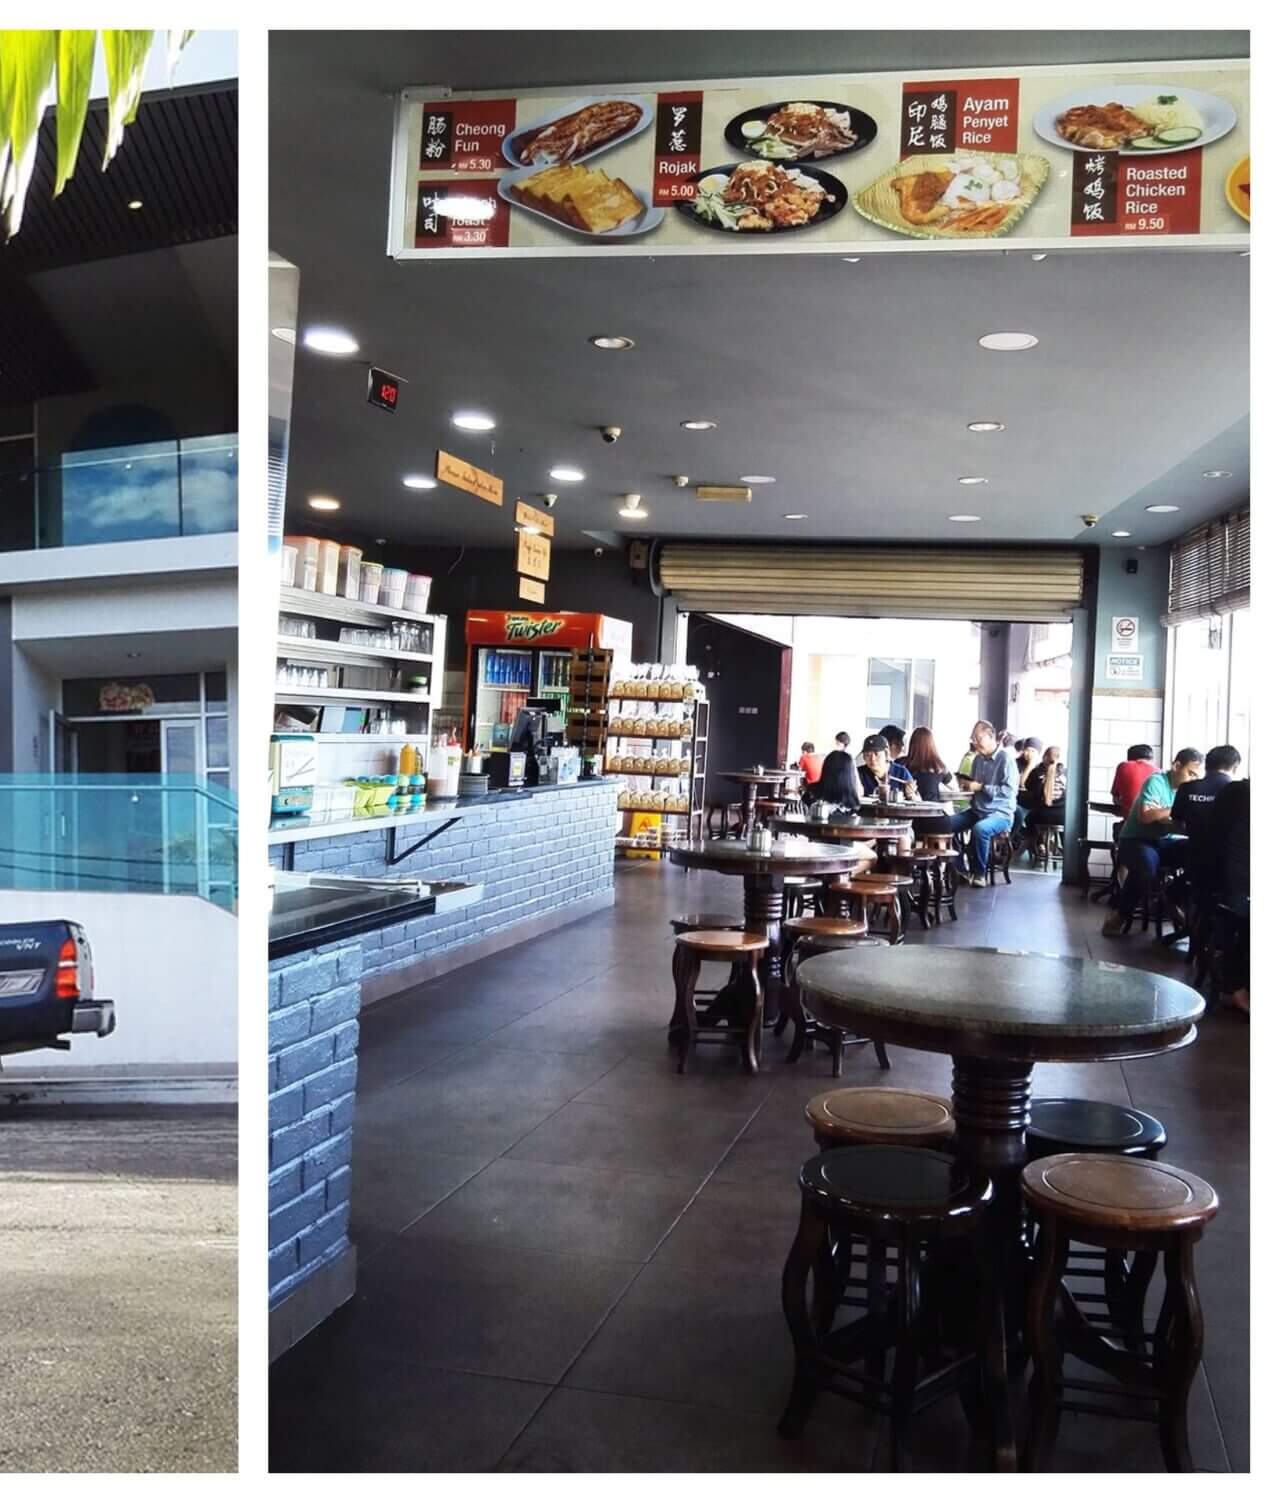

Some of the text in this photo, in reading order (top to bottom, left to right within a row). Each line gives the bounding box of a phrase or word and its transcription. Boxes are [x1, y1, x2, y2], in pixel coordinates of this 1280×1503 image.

[963, 97, 1009, 115] Ayam
[669, 106, 688, 152] 罗惹
[908, 101, 927, 147] 印尼
[929, 94, 948, 149] 鸡腿饭
[963, 115, 1009, 130] Penyet
[455, 122, 506, 137] Cheong
[426, 116, 447, 159] 肠粉
[962, 131, 992, 144] Rice
[454, 139, 480, 152] Fun
[469, 158, 492, 170] 5.30
[659, 161, 697, 176] Rojak
[1126, 166, 1188, 181] Roasted
[671, 184, 695, 197] 5.00
[1083, 155, 1105, 221] 烤鸡饭
[1125, 184, 1186, 197] Chicken
[1125, 200, 1158, 214] Rice
[1124, 217, 1165, 230] RM 9.50
[464, 231, 487, 242] 3.30
[506, 619, 561, 641] Twister
